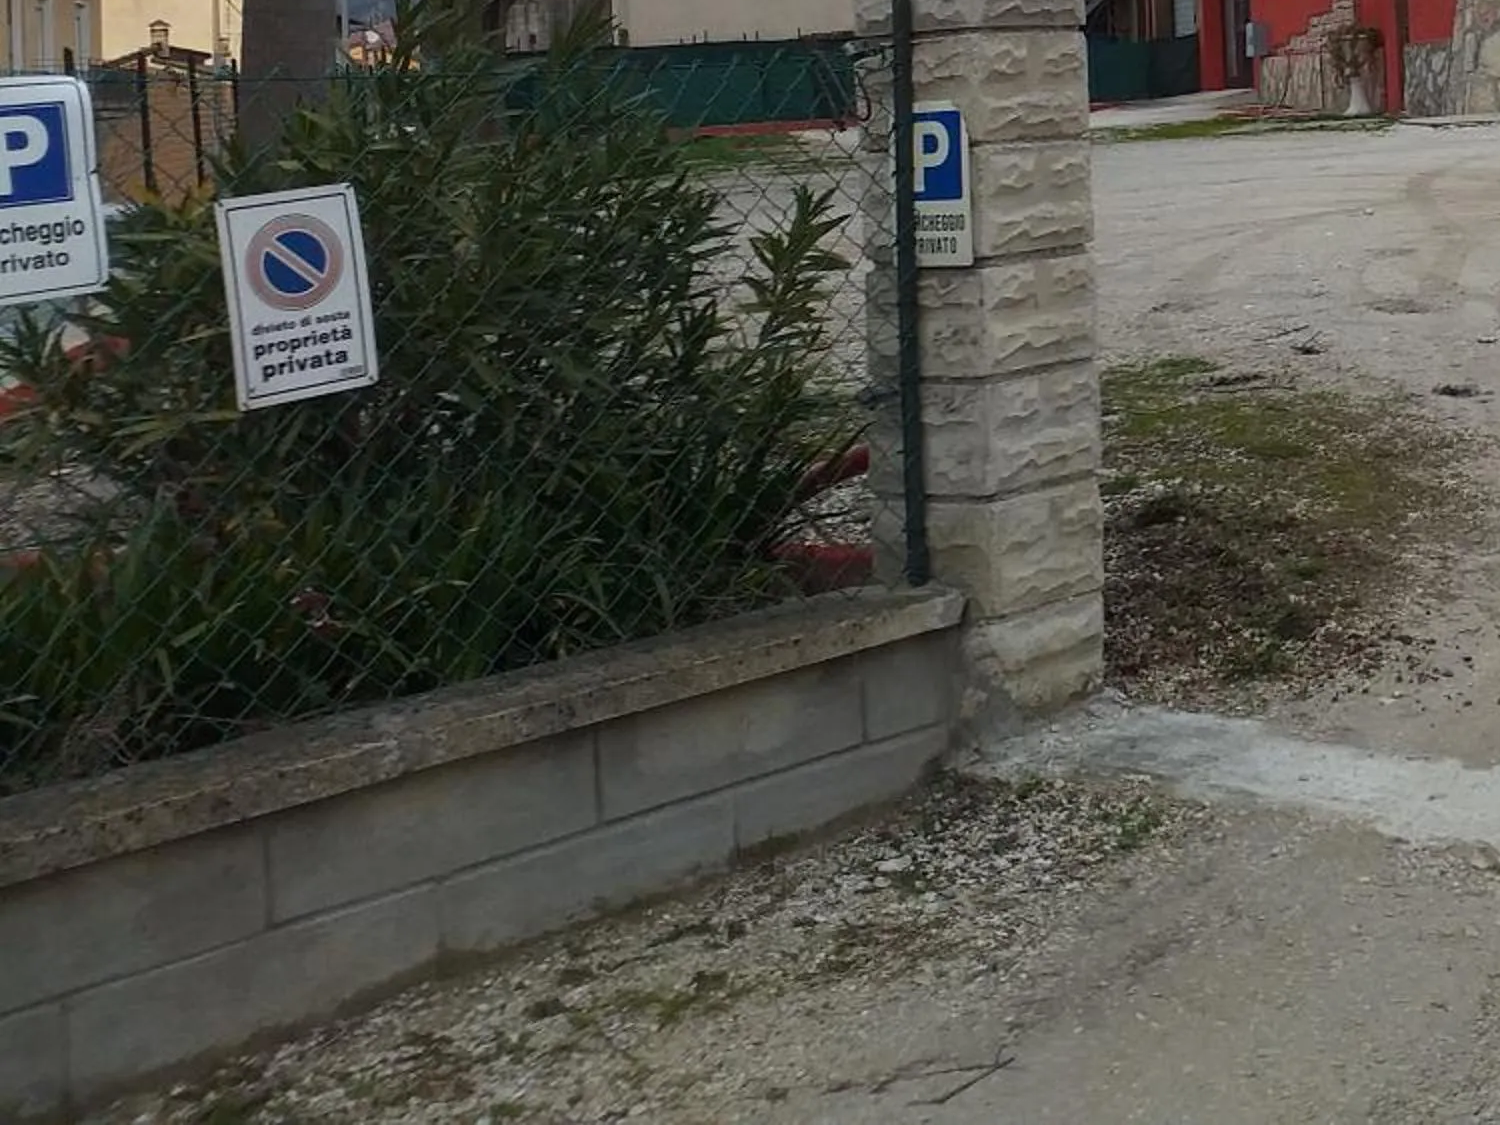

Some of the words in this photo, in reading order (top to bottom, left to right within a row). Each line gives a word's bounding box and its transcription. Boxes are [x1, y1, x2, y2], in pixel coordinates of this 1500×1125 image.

[0, 115, 49, 196] P
[913, 121, 949, 192] P
[0, 216, 85, 245] cheggio
[917, 237, 957, 254] RIVATO
[0, 251, 70, 273] rivato
[253, 325, 353, 361] proprietà
[262, 349, 349, 382] privata
